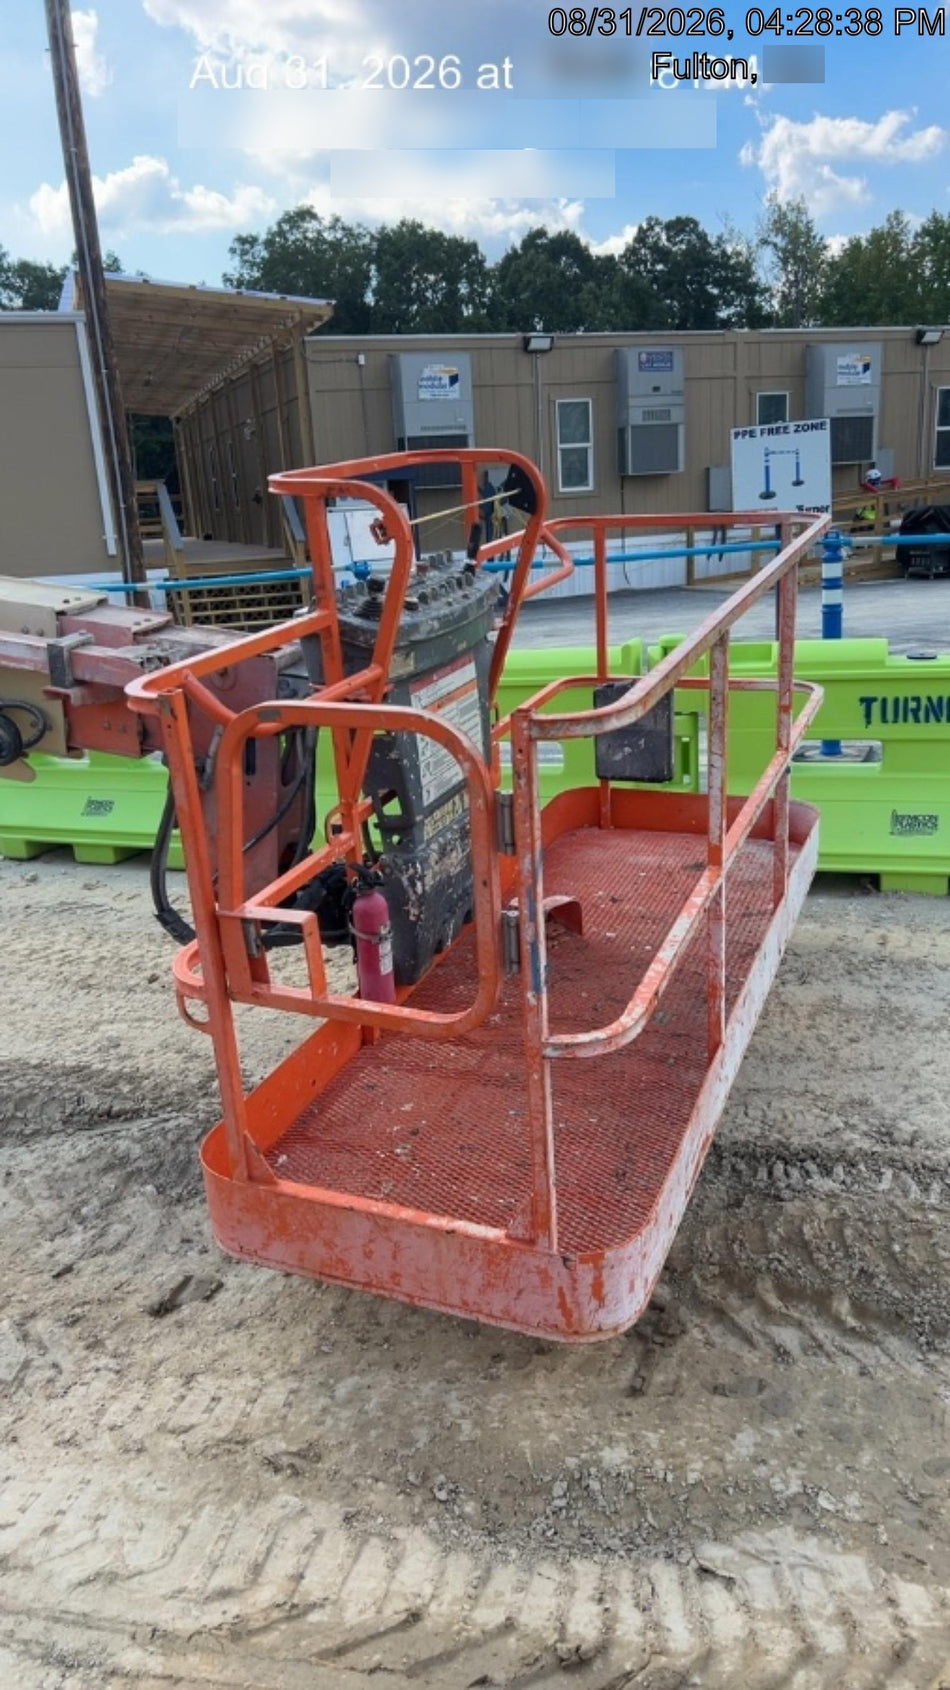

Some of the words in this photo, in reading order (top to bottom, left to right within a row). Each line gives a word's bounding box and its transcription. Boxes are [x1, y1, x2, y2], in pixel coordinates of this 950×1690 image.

[733, 428, 757, 440] PPE
[760, 424, 791, 437] FREE
[793, 420, 828, 433] ZONE
